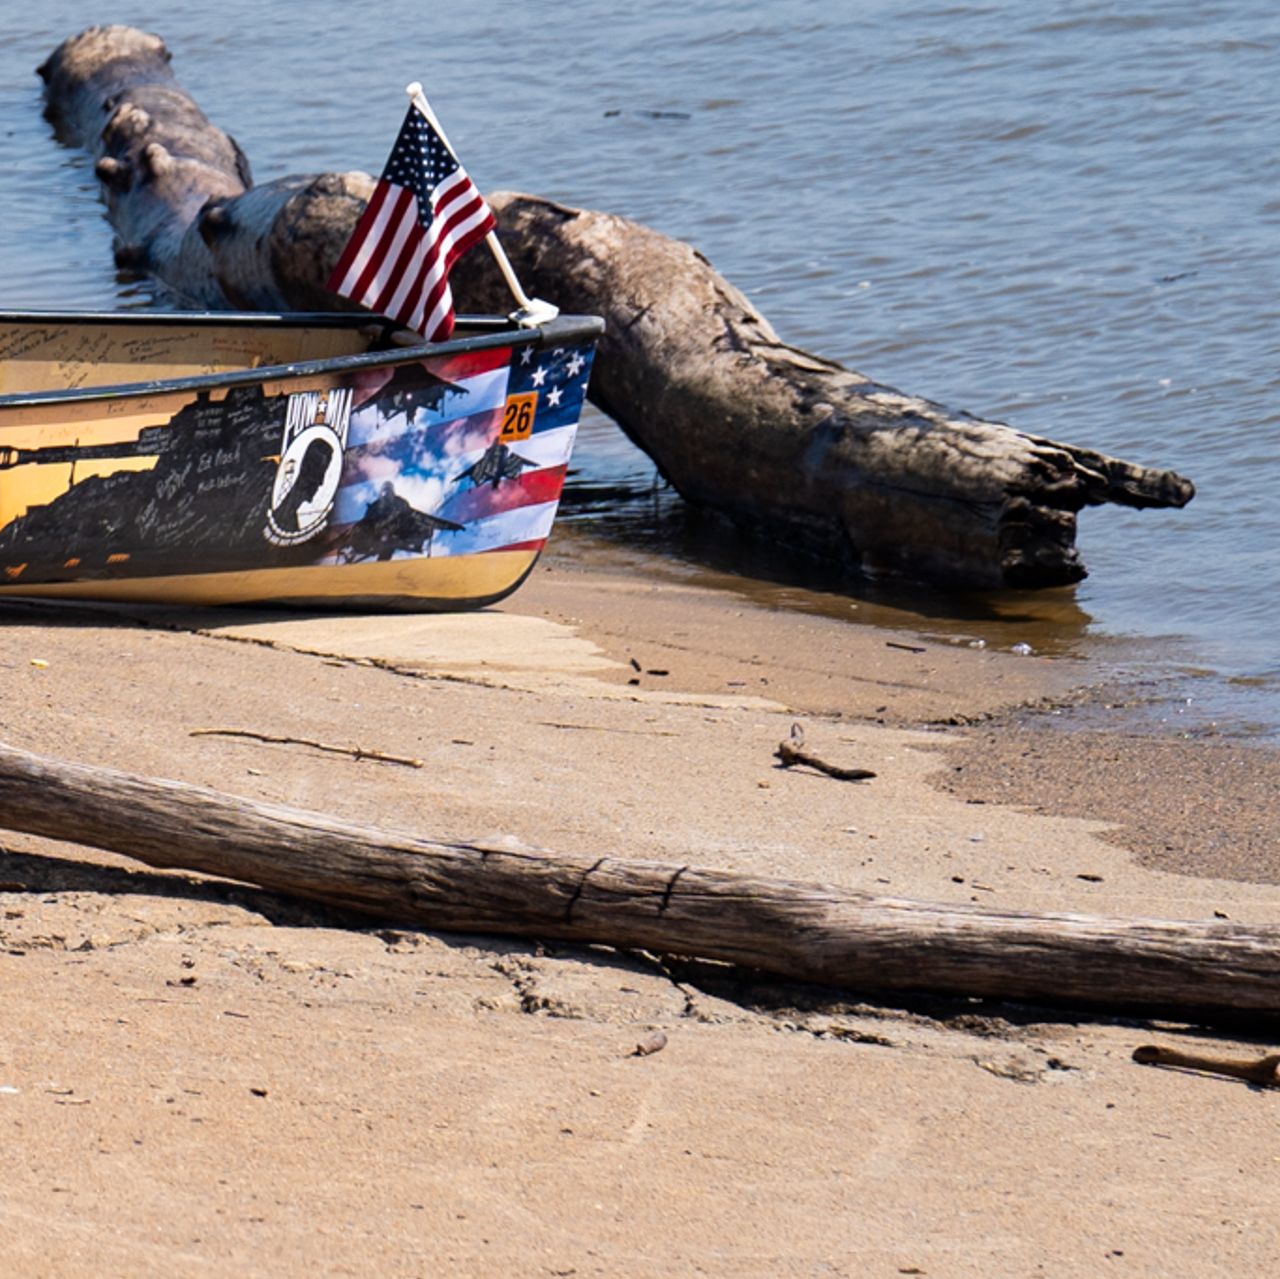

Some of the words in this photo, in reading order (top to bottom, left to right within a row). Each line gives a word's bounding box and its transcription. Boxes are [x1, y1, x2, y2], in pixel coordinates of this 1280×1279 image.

[281, 392, 320, 458] POW
[324, 388, 354, 451] MIA
[502, 401, 532, 436] 26
